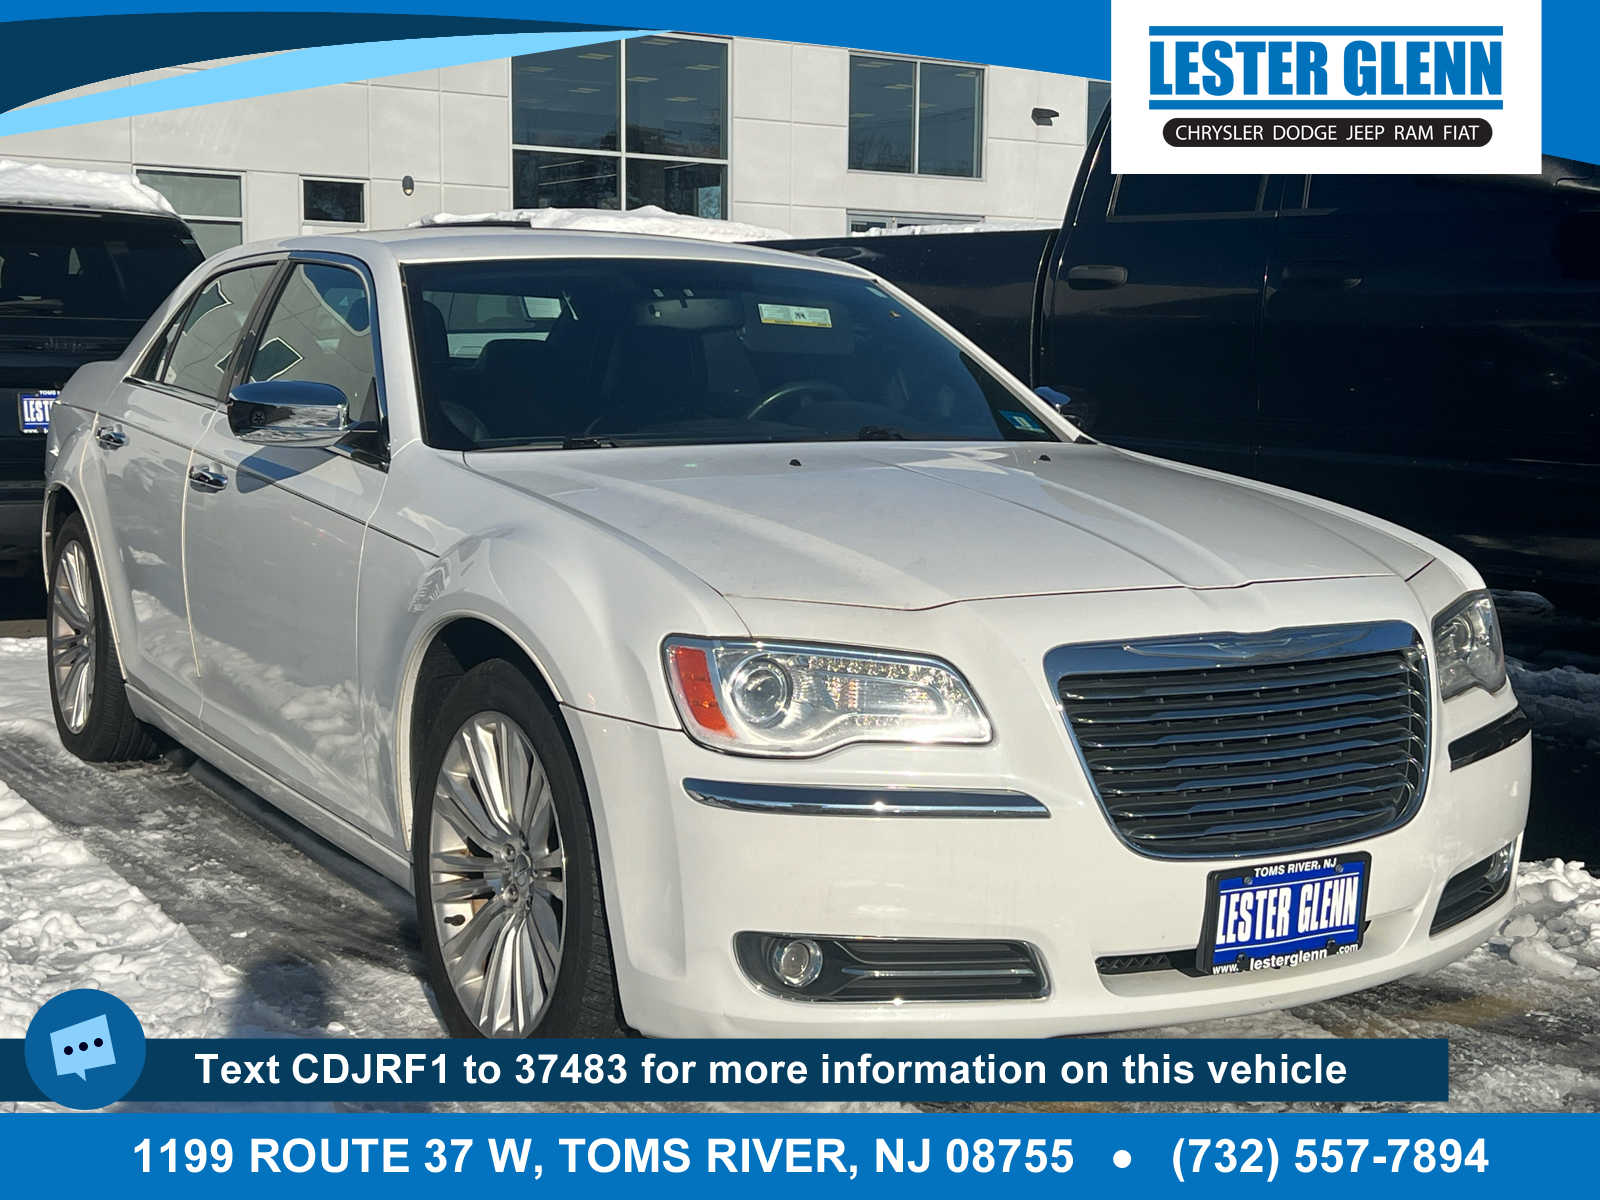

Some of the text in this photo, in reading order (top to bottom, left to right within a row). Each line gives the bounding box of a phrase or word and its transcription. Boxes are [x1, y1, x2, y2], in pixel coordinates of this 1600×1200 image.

[1254, 857, 1337, 878] TOMS RIVER, NJ
[1215, 876, 1360, 945] LESTER GLENN
[1212, 943, 1359, 975] www. lesterglenn .com
